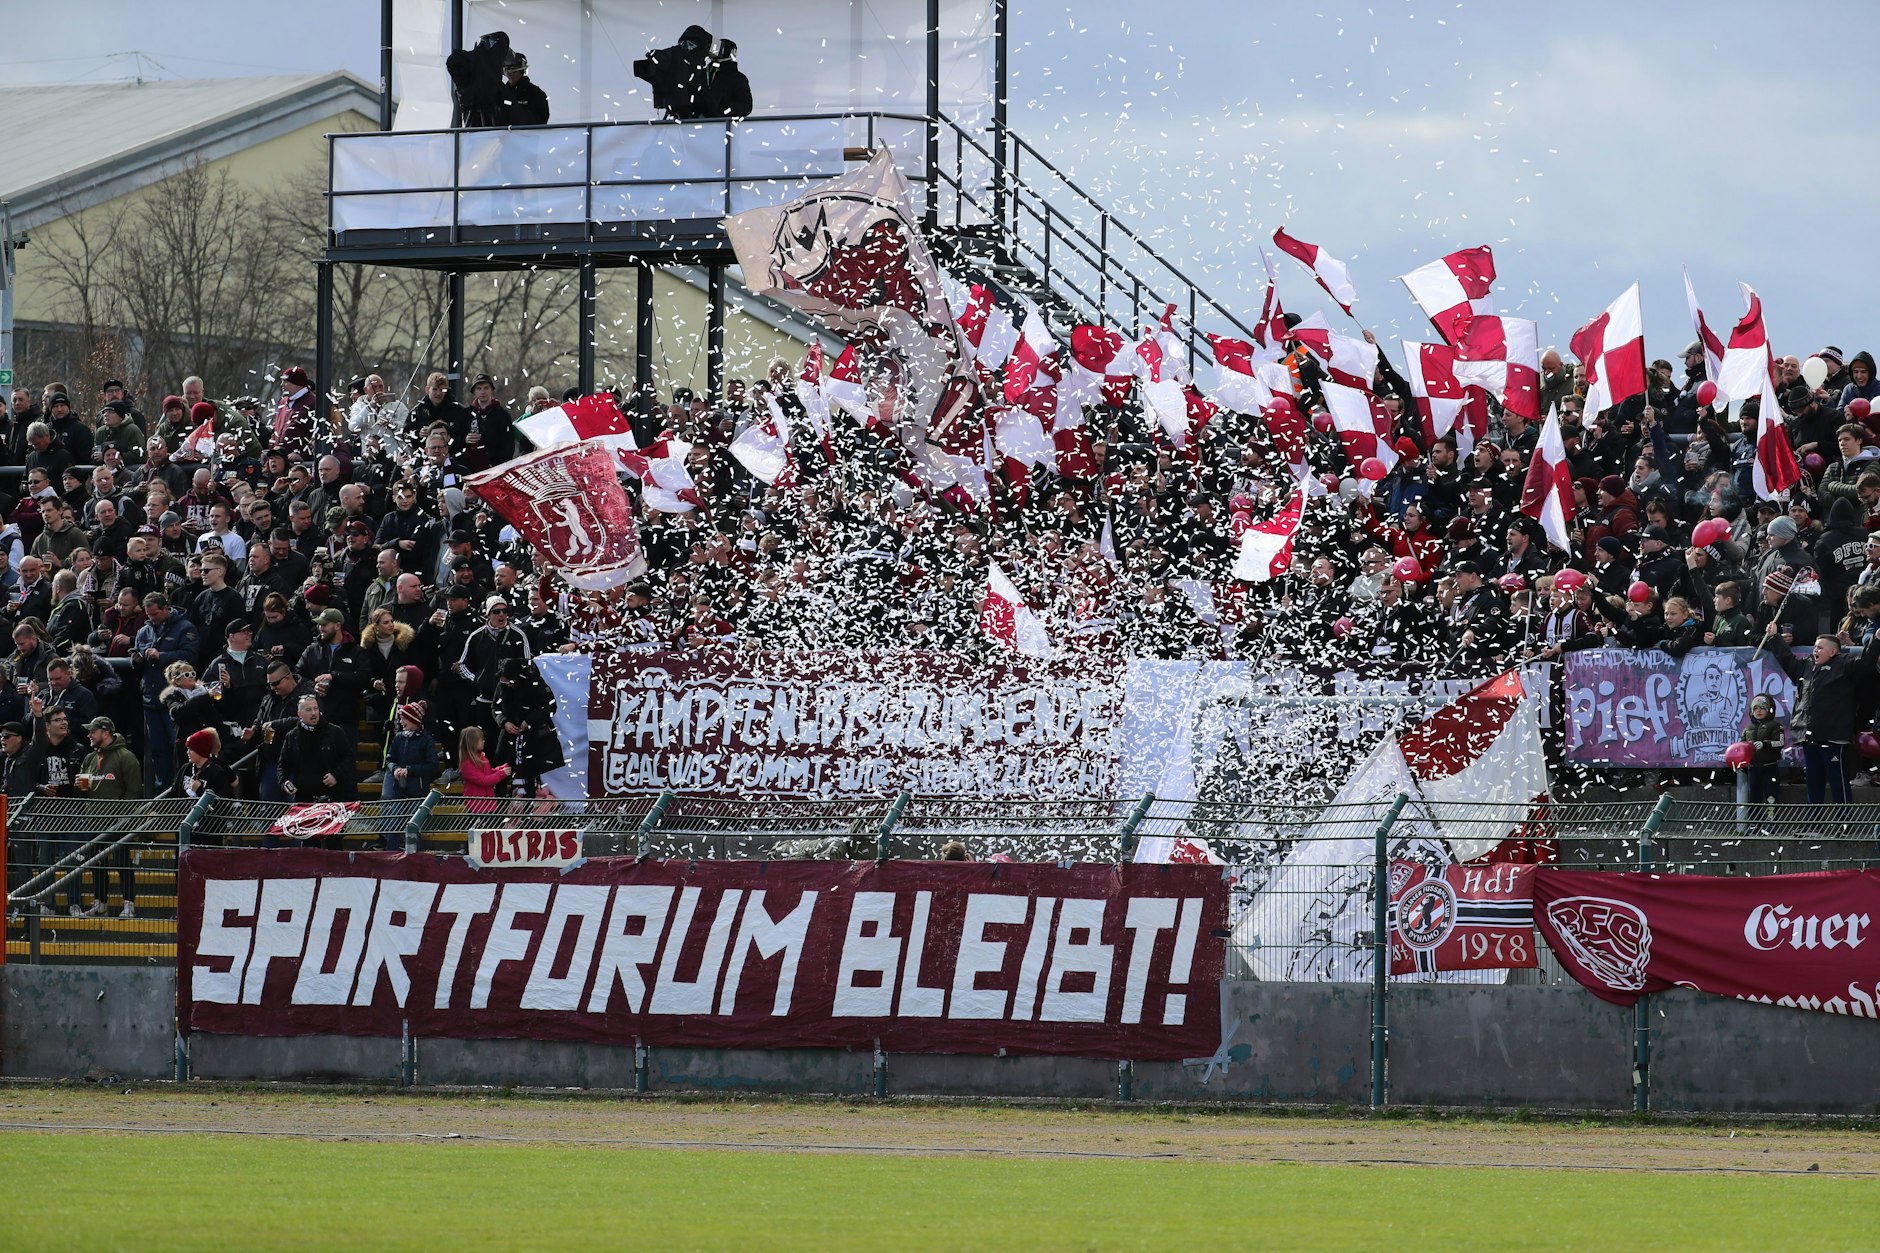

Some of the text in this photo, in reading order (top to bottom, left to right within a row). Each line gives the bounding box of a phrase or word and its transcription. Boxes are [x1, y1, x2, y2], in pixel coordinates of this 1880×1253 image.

[613, 673, 800, 748] KÄMPFEN
[609, 752, 665, 788] EGAL
[667, 752, 721, 787] WAS
[480, 830, 579, 864] ULTRAS
[192, 877, 1204, 1026] SPORTFORUM BLEIBT!
[1408, 929, 1440, 943] DYNAMO
[1457, 932, 1528, 962] 1978
